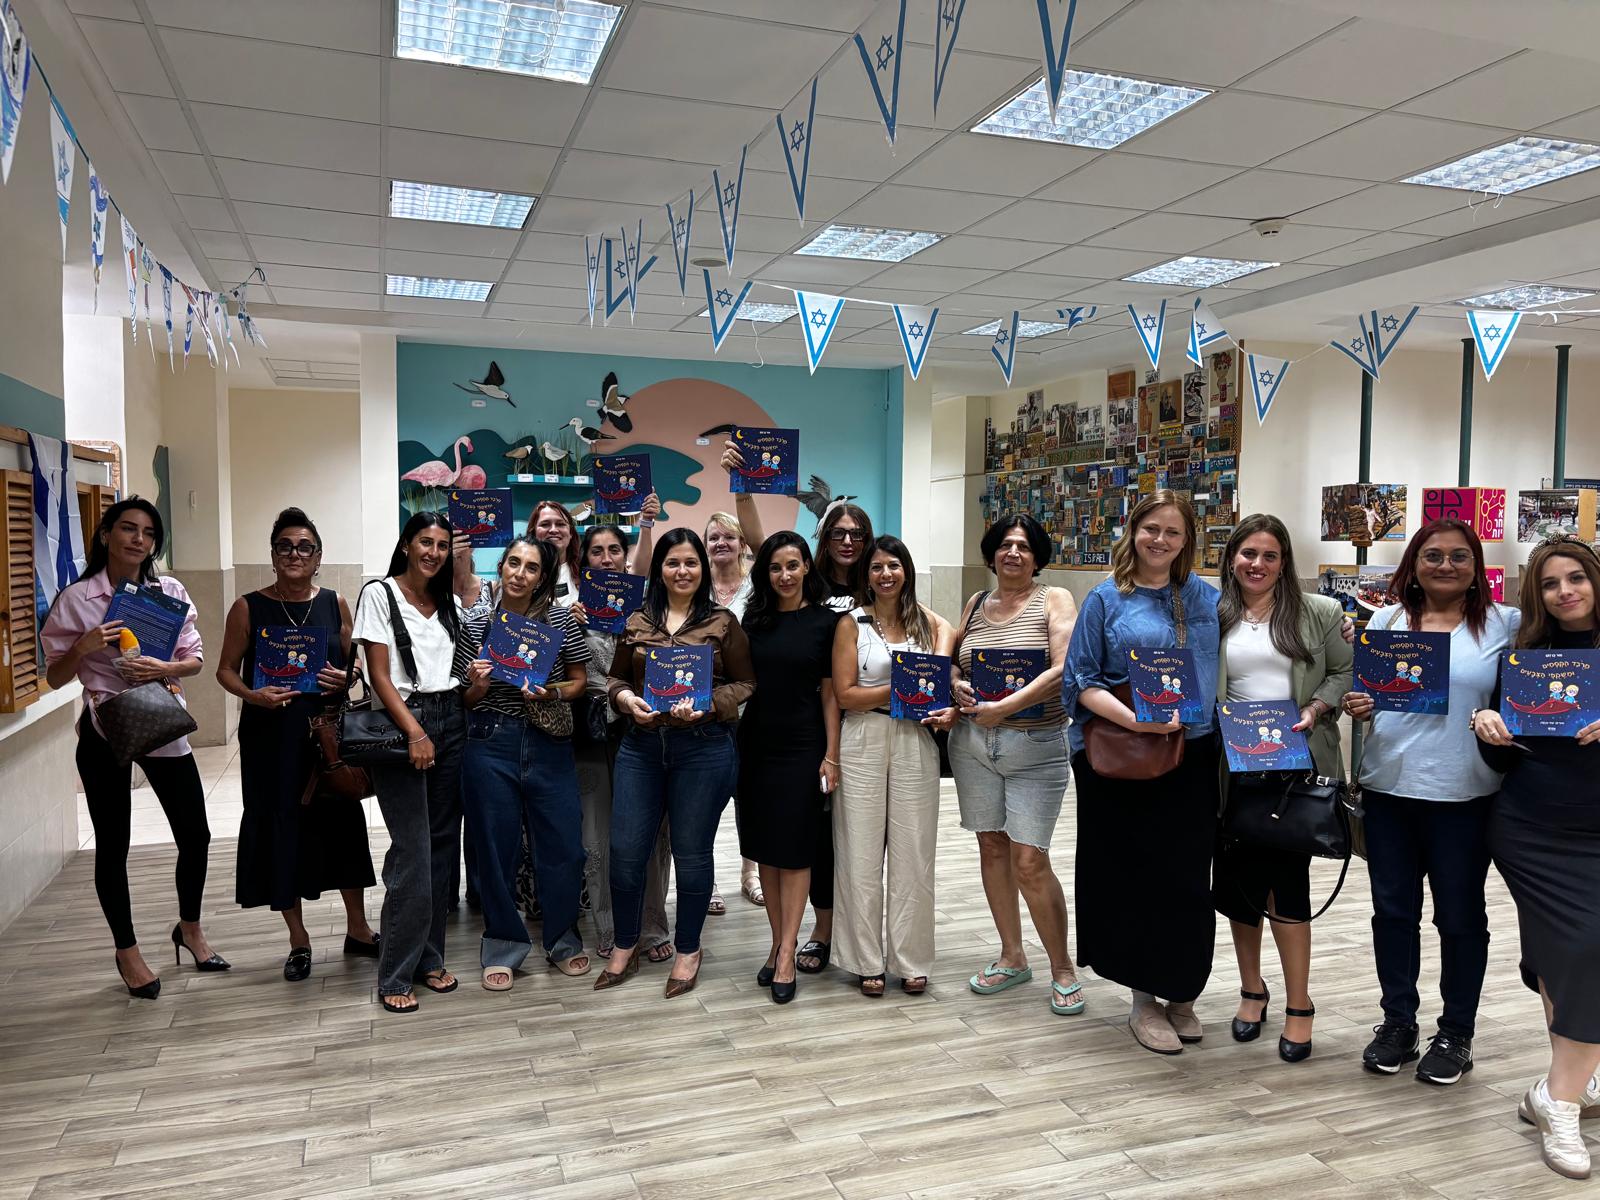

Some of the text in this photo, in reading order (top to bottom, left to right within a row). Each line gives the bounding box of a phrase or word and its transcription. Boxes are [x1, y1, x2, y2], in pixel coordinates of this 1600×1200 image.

[1494, 518, 1503, 528] חר
[1491, 529, 1503, 538] יות
[1083, 553, 1106, 563] ISRAEL
[1571, 660, 1590, 669] מרבד
